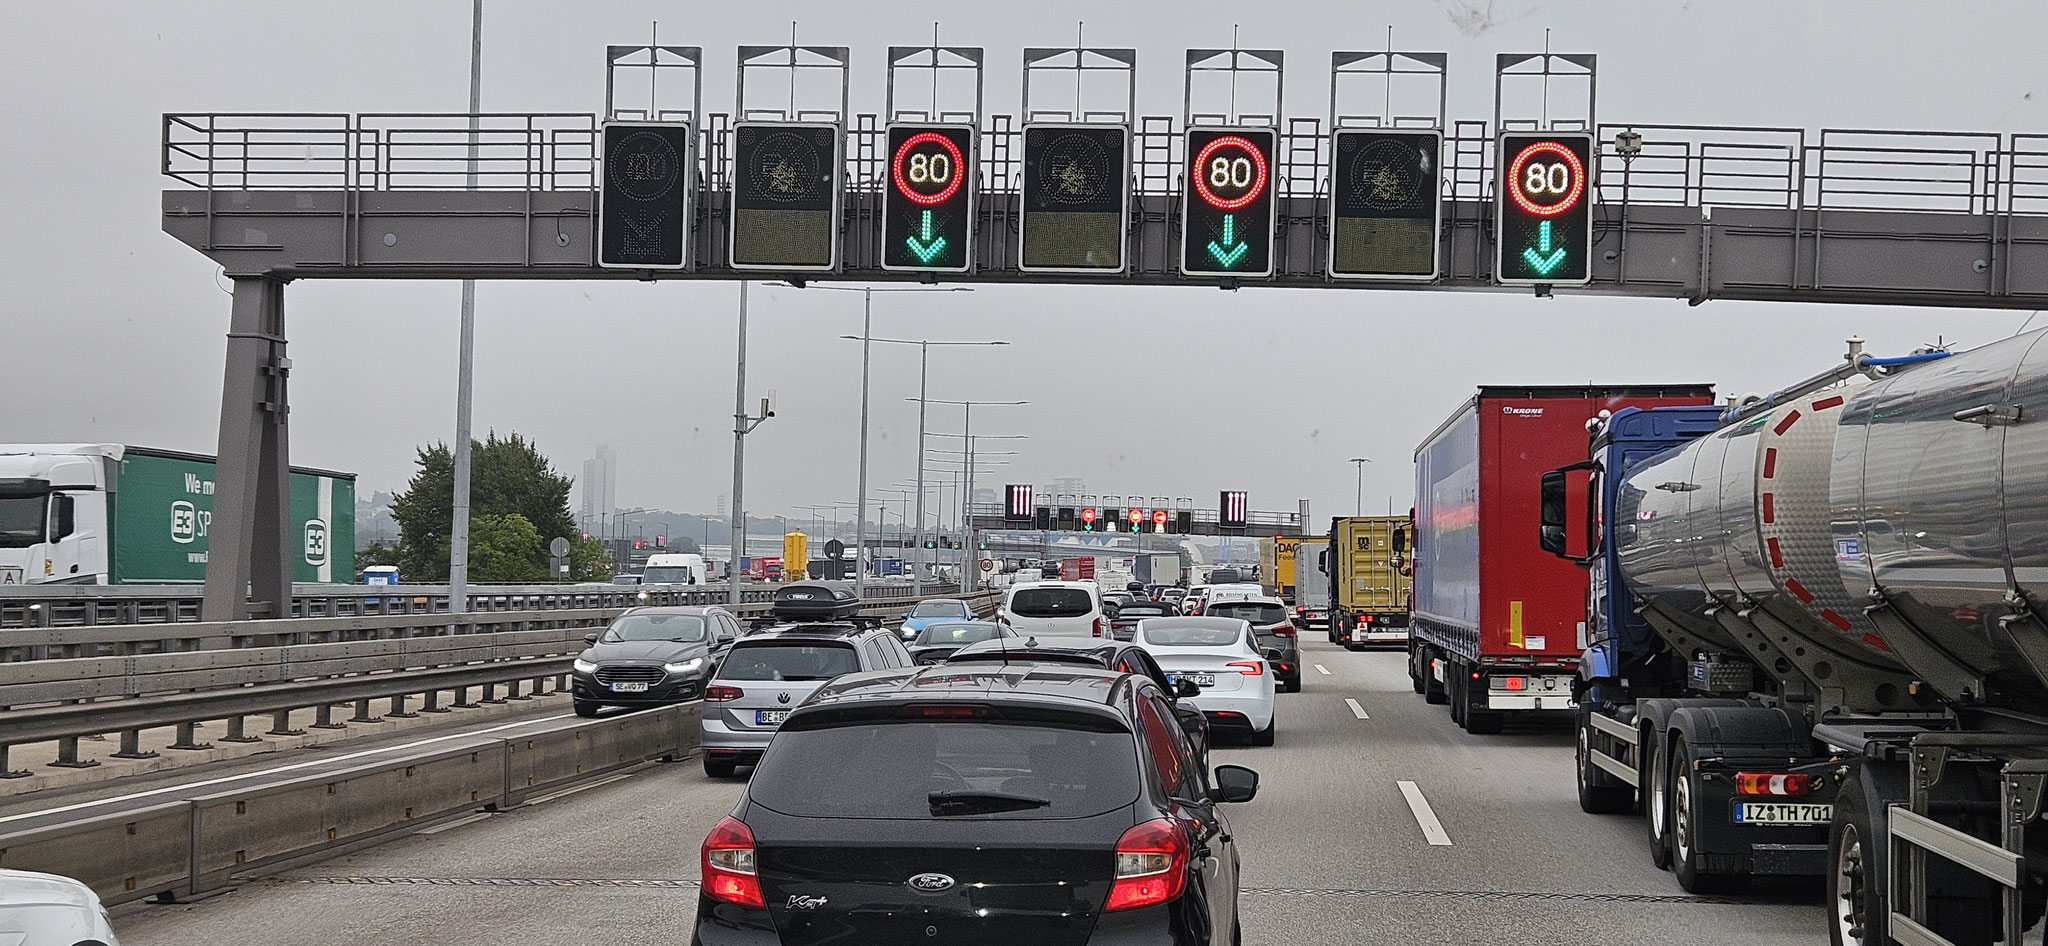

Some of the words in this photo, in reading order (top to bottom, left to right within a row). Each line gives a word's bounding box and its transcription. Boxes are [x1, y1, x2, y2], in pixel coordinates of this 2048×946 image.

[910, 153, 948, 182] 80
[1211, 157, 1250, 187] 80
[1526, 163, 1568, 193] 80
[185, 473, 200, 494] We
[173, 510, 193, 534] E3
[307, 529, 325, 555] E3
[4, 571, 15, 584] A
[1198, 676, 1213, 684] 214
[762, 712, 773, 722] BE
[1745, 805, 1765, 820] IZ
[1777, 806, 1798, 820] TH
[1801, 806, 1831, 821] 701
[918, 876, 947, 888] Ford
